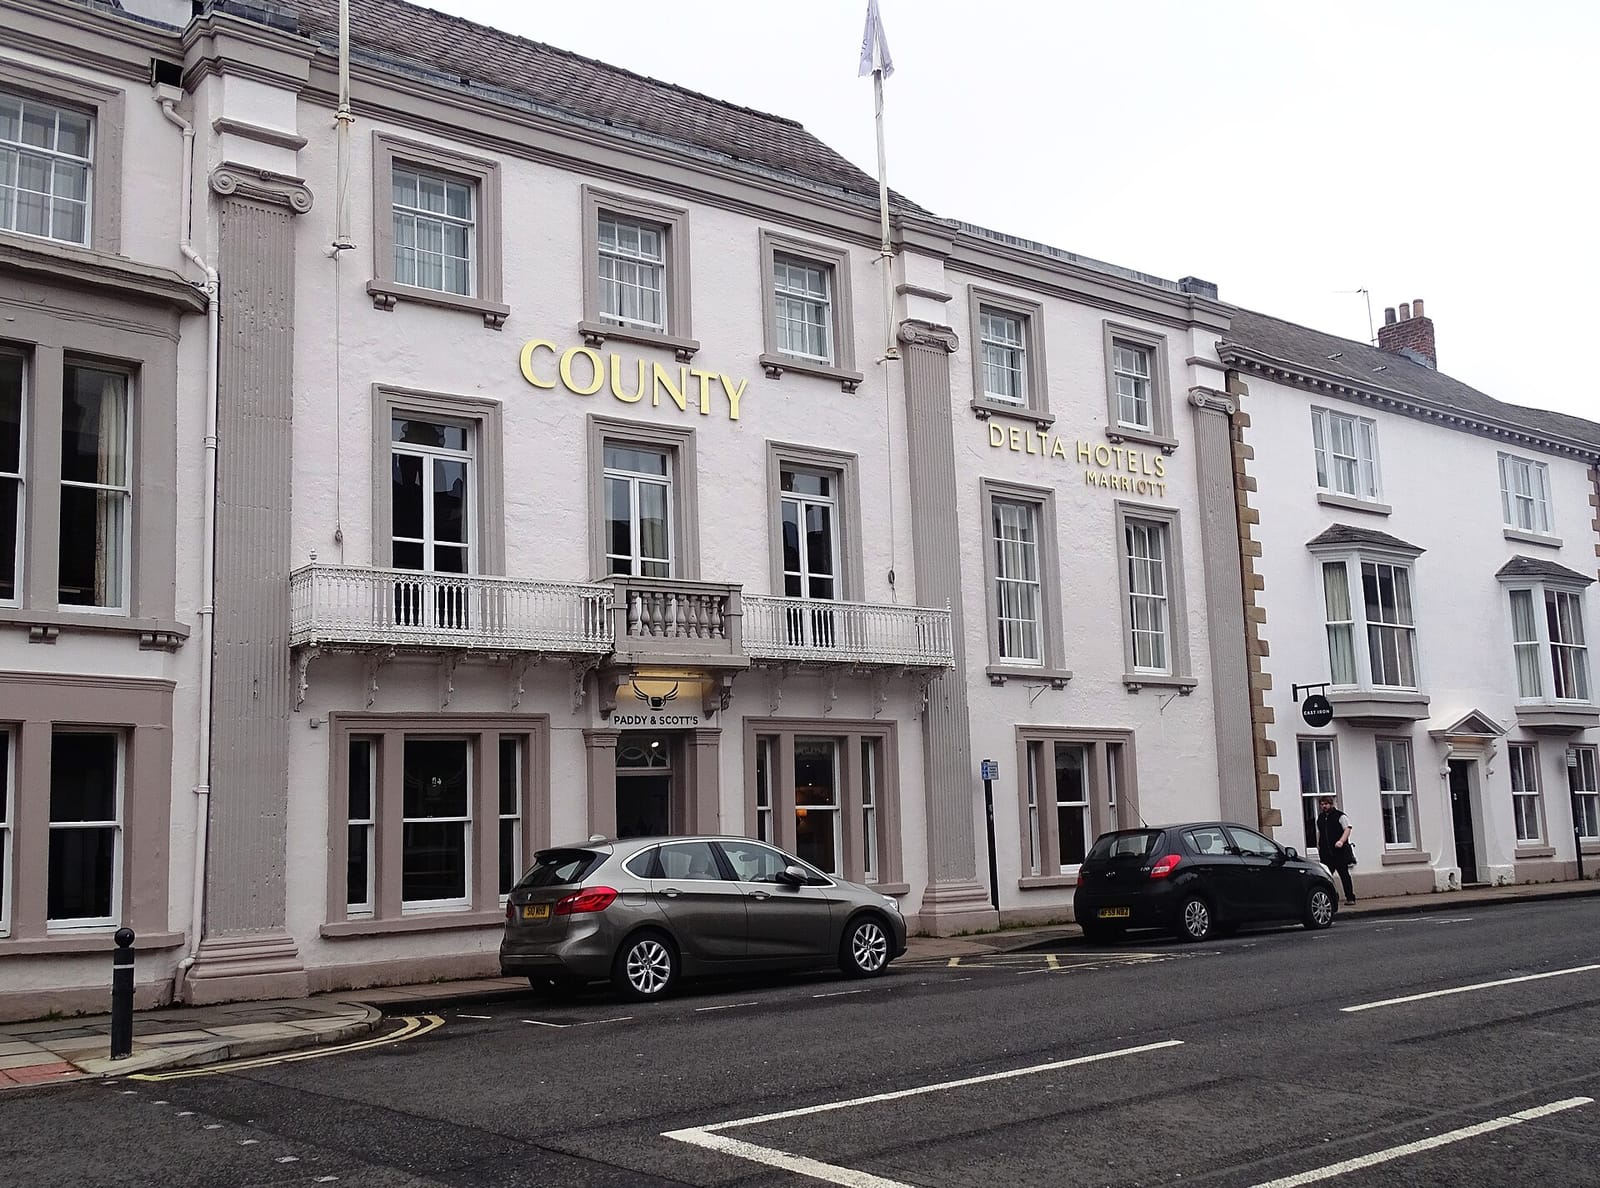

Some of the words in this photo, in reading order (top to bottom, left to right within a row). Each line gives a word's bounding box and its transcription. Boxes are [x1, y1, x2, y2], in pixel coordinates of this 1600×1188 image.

[519, 339, 748, 420] COUNTY
[988, 423, 1066, 459] DELTA
[1076, 439, 1165, 477] HOTELS
[1085, 469, 1166, 497] MARRIOTT
[614, 715, 648, 725] PADDY
[649, 715, 657, 725] &
[659, 715, 699, 725] SCOTT'S
